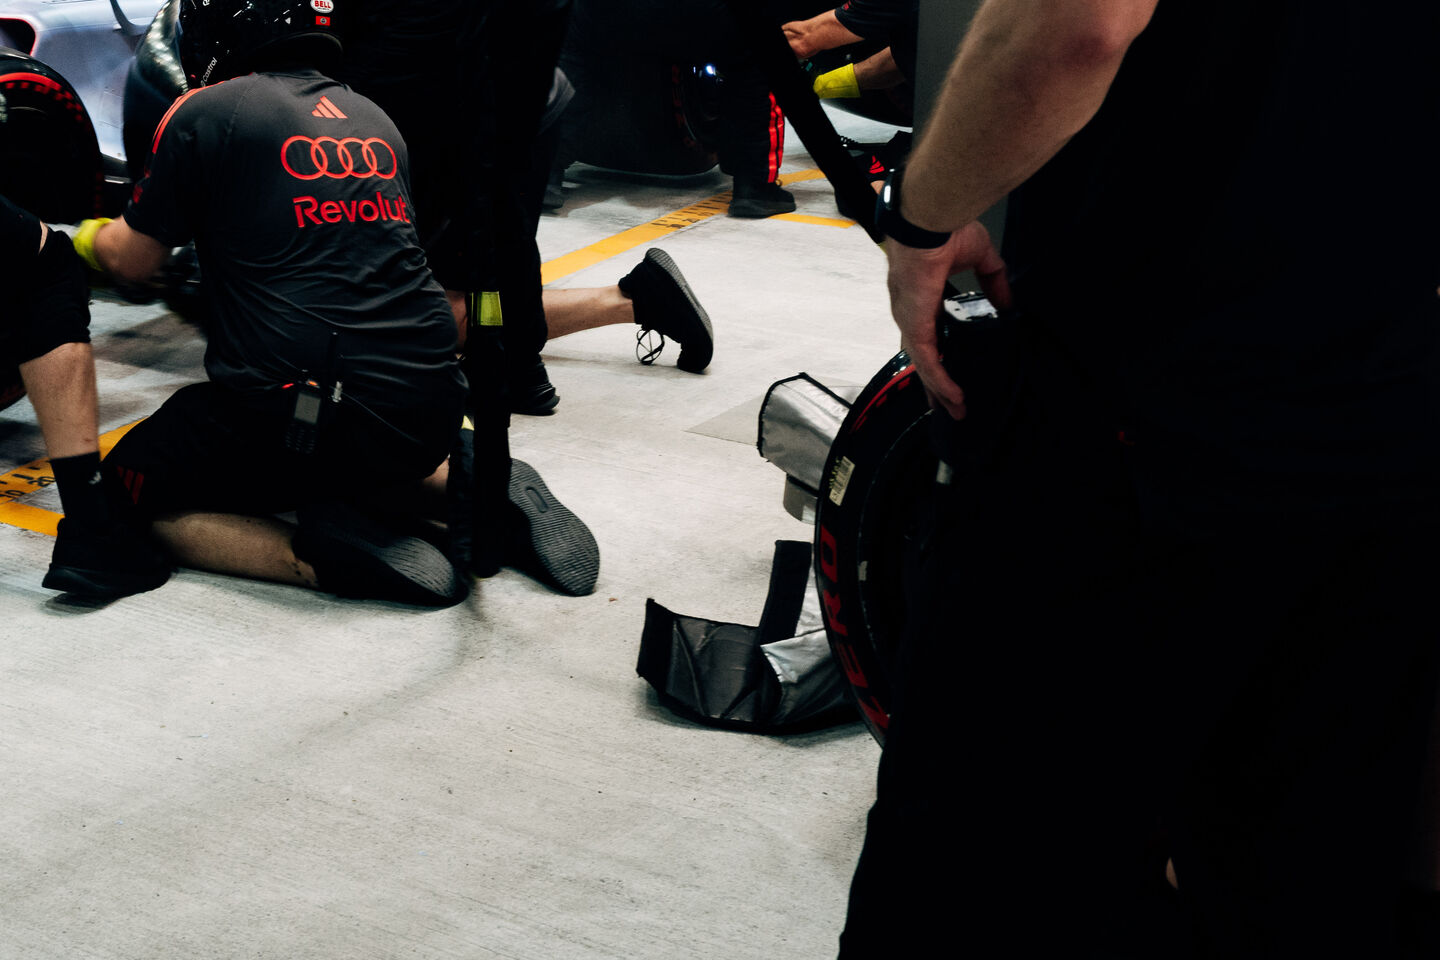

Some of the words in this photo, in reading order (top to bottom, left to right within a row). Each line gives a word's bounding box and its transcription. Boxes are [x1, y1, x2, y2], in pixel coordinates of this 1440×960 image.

[314, 0, 332, 9] BELL
[202, 56, 218, 81] Castrol
[292, 191, 411, 228] Revolut
